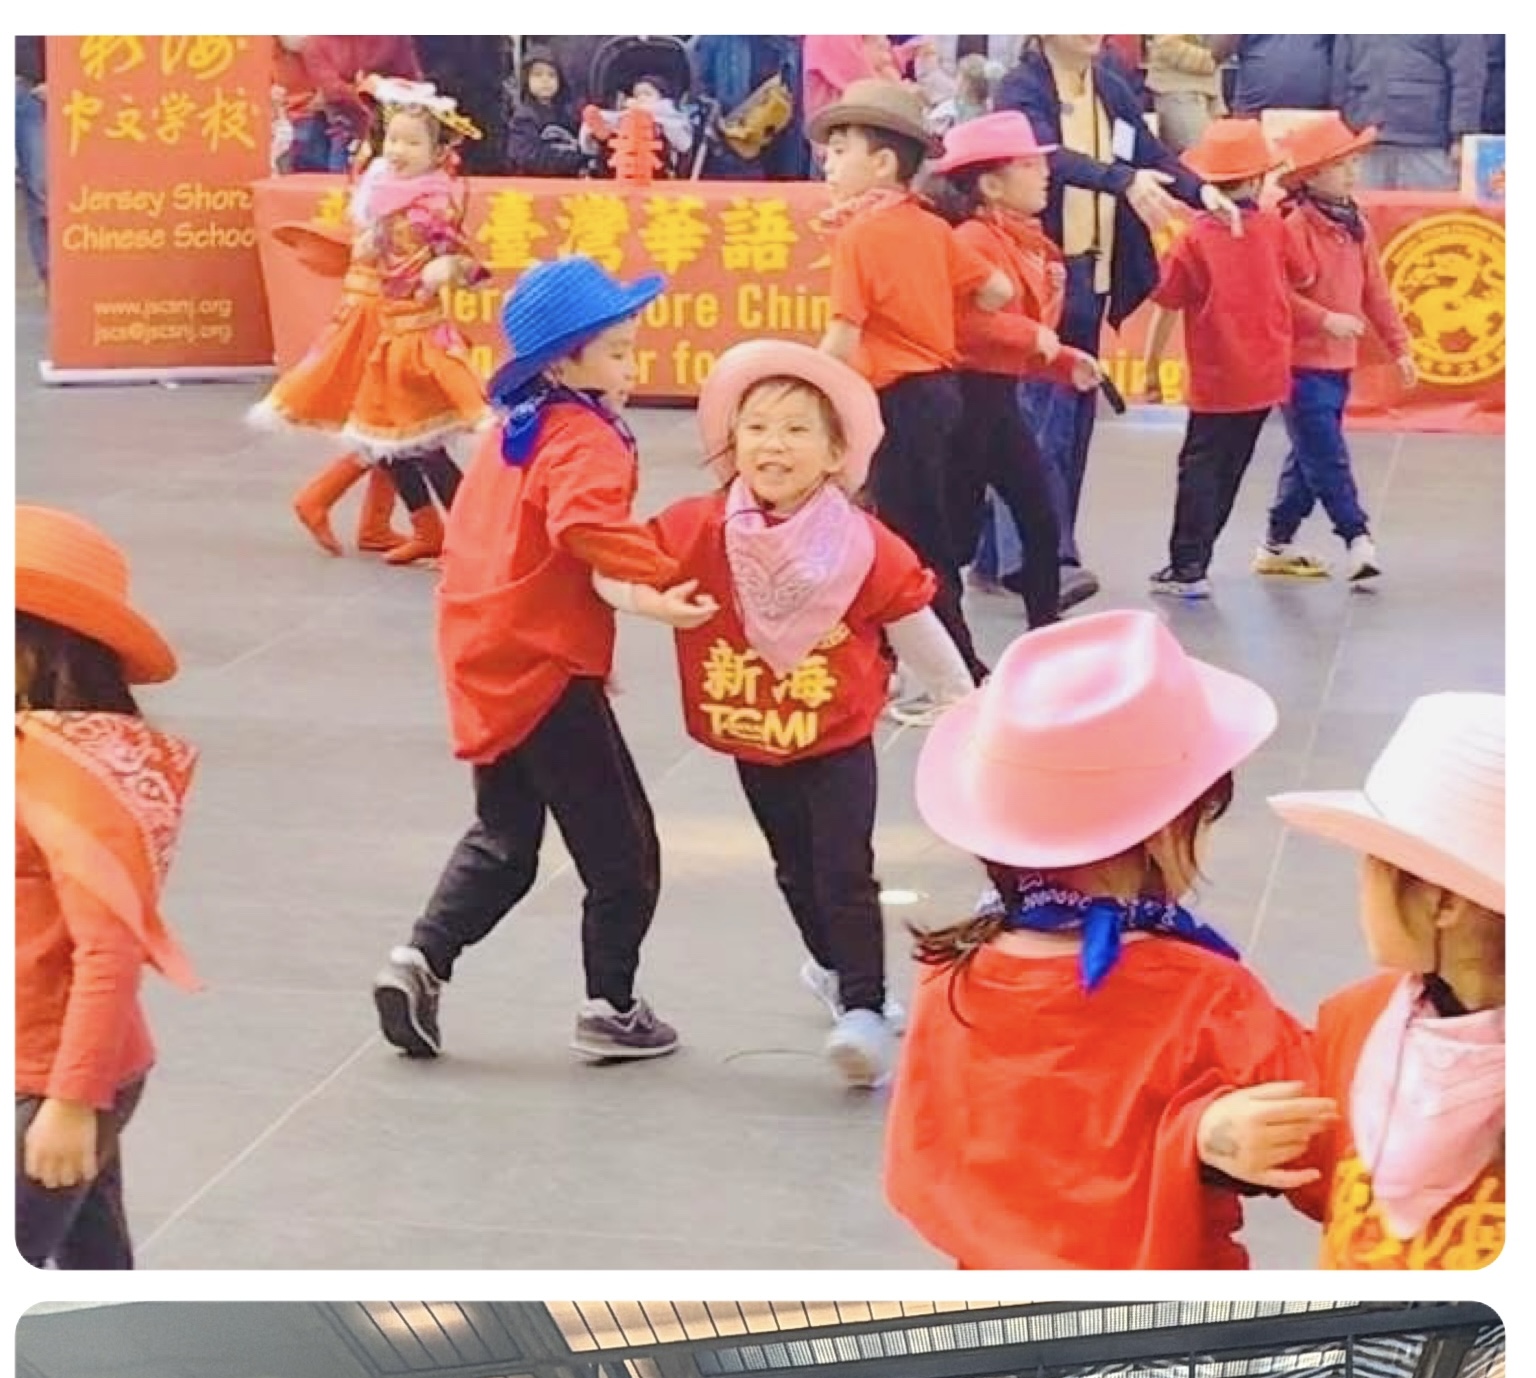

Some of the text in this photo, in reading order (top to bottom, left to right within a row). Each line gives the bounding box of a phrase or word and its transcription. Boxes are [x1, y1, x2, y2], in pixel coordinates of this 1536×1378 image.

[68, 185, 165, 218] Jersey
[63, 224, 164, 248] Chinese
[476, 190, 832, 273] 臺灣華語
